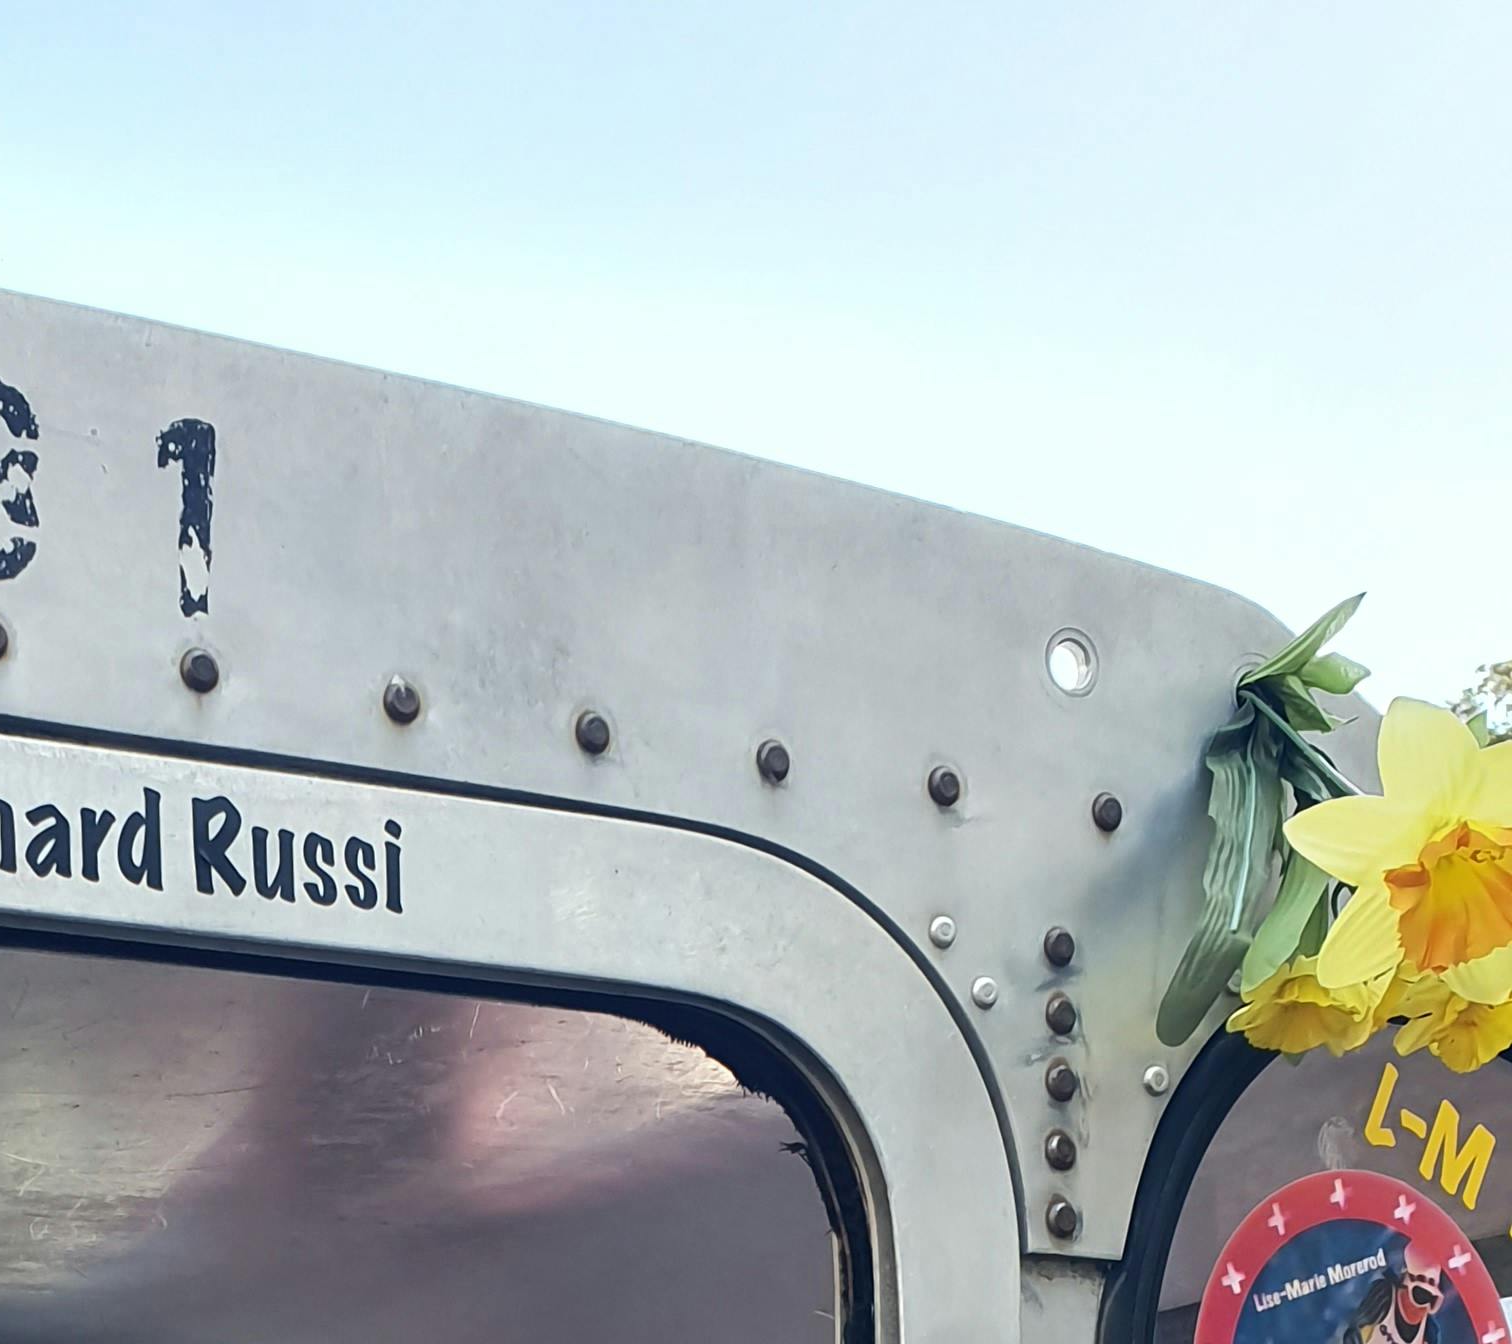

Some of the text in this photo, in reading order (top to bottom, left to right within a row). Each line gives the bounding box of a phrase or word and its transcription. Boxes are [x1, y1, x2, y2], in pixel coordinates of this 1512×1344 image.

[191, 794, 404, 915] Russi
[1364, 1061, 1497, 1211] L-M
[1252, 1247, 1387, 1313] Lise-Marie Morerod
